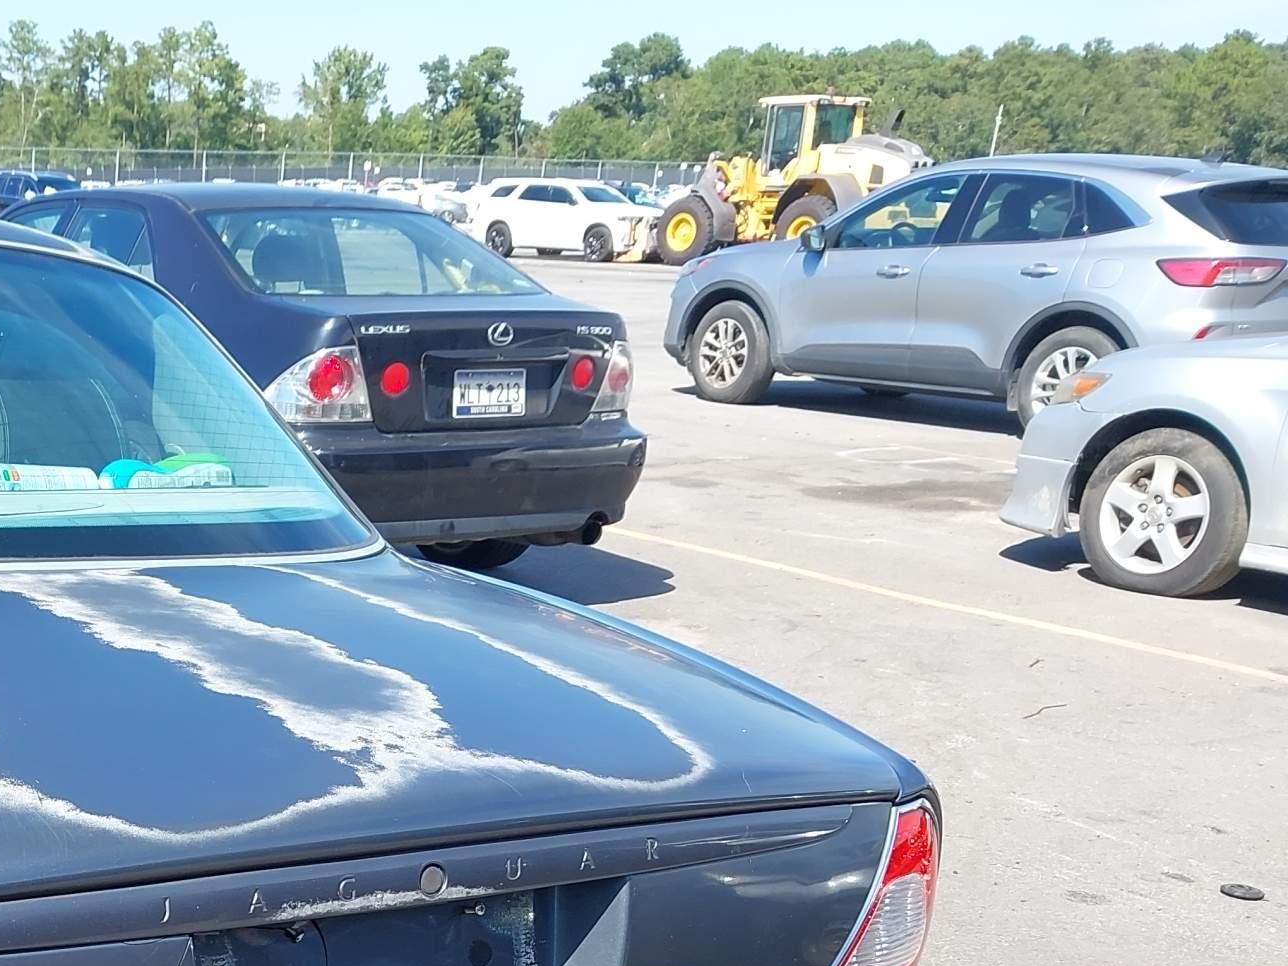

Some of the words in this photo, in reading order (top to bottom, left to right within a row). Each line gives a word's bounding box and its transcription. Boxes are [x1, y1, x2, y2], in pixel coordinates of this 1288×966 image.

[360, 324, 411, 335] LEXUS
[458, 383, 484, 405] WLT
[496, 382, 521, 404] 213
[158, 836, 661, 925] JAGUAR
